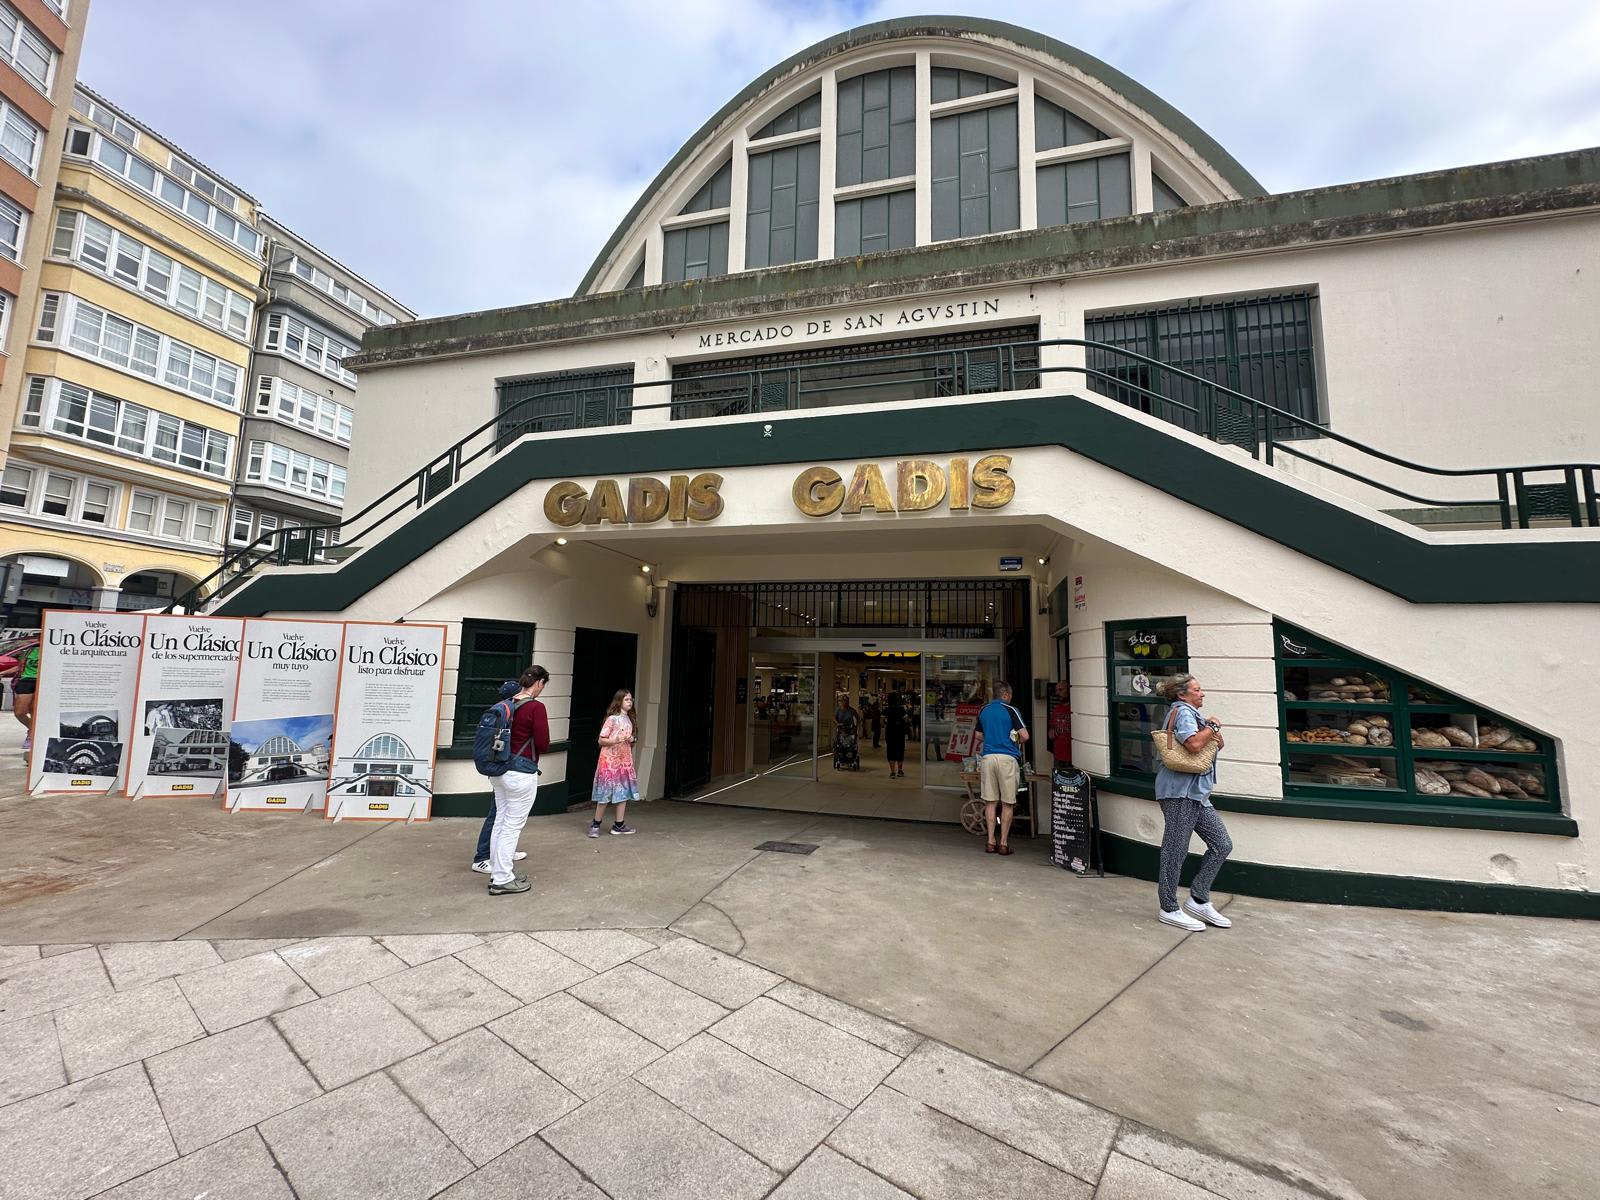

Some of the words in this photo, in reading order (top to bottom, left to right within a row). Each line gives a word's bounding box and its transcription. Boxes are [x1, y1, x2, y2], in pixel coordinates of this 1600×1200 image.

[699, 325, 794, 348] MERCADO
[806, 320, 833, 336] DE
[844, 313, 885, 330] SAN
[896, 299, 1001, 325] AGVSTIN
[791, 454, 1017, 518] GADIS
[543, 472, 725, 528] GADIS
[84, 621, 107, 629] Vuelve
[188, 625, 211, 633] Vuelve
[48, 628, 76, 646] Un
[80, 629, 141, 648] Clásico
[149, 632, 178, 651] Un
[283, 633, 304, 641] Vuelve
[384, 637, 405, 645] Vuelve
[60, 647, 71, 655] de
[72, 647, 79, 655] la
[80, 649, 127, 658] arquitectura
[151, 651, 163, 660] de
[164, 651, 177, 660] los
[248, 640, 273, 659] Un
[278, 641, 337, 661] Clásico
[348, 645, 374, 664] Un
[379, 646, 438, 666] Clásico
[272, 662, 290, 671] muy
[291, 662, 309, 672] tuyo
[358, 665, 375, 674] listo
[375, 667, 393, 676] para
[393, 666, 426, 676] disfrutar
